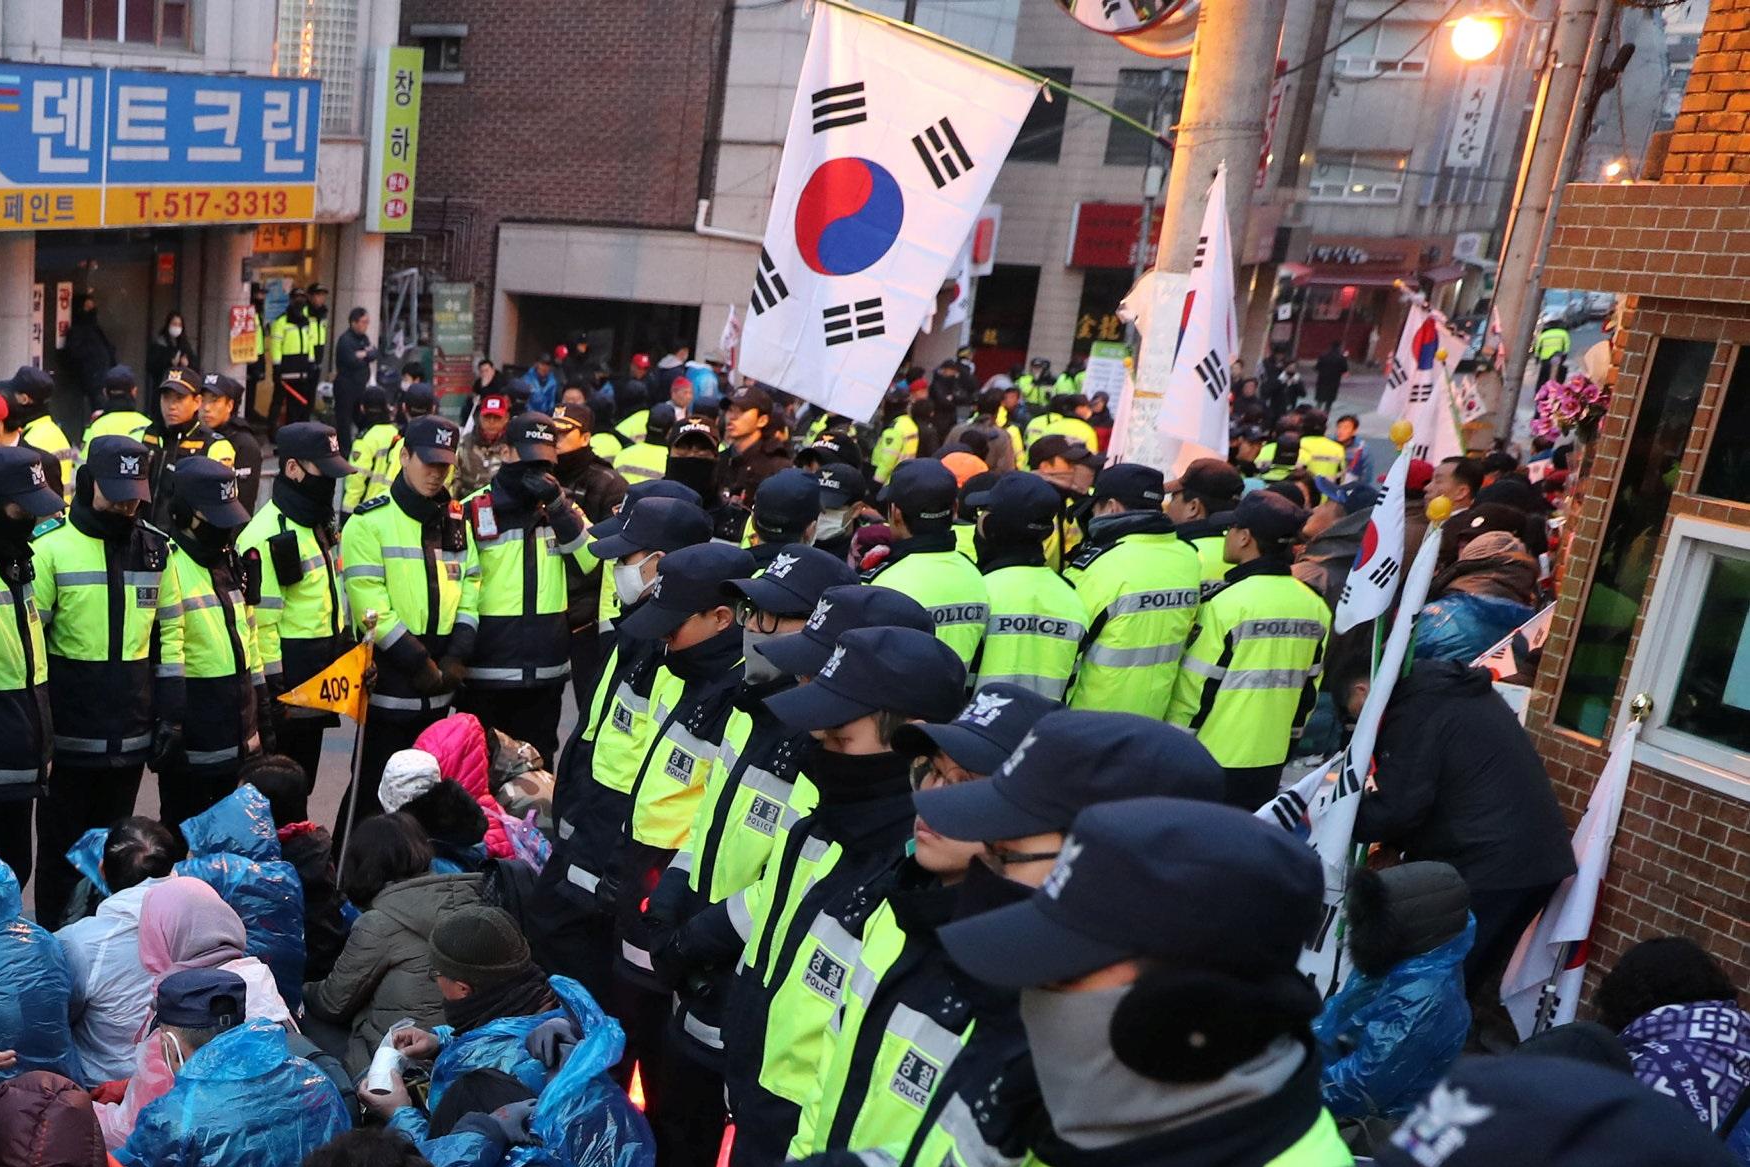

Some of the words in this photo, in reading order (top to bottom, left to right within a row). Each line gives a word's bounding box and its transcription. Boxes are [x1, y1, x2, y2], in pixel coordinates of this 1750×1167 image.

[32, 76, 309, 173] 덴트크린
[135, 190, 288, 219] T.517-3313
[933, 606, 984, 624] OLICE
[999, 616, 1068, 636] POLICE
[1253, 621, 1320, 636] POLICE
[666, 766, 689, 782] POLICE
[672, 750, 692, 774] 경찰
[752, 797, 778, 823] 경찰
[747, 815, 773, 833] POLICE
[811, 950, 843, 987] 경찰
[805, 973, 837, 1000] POLICE
[900, 1051, 934, 1090] 경찰
[893, 1078, 927, 1107] POLICE
